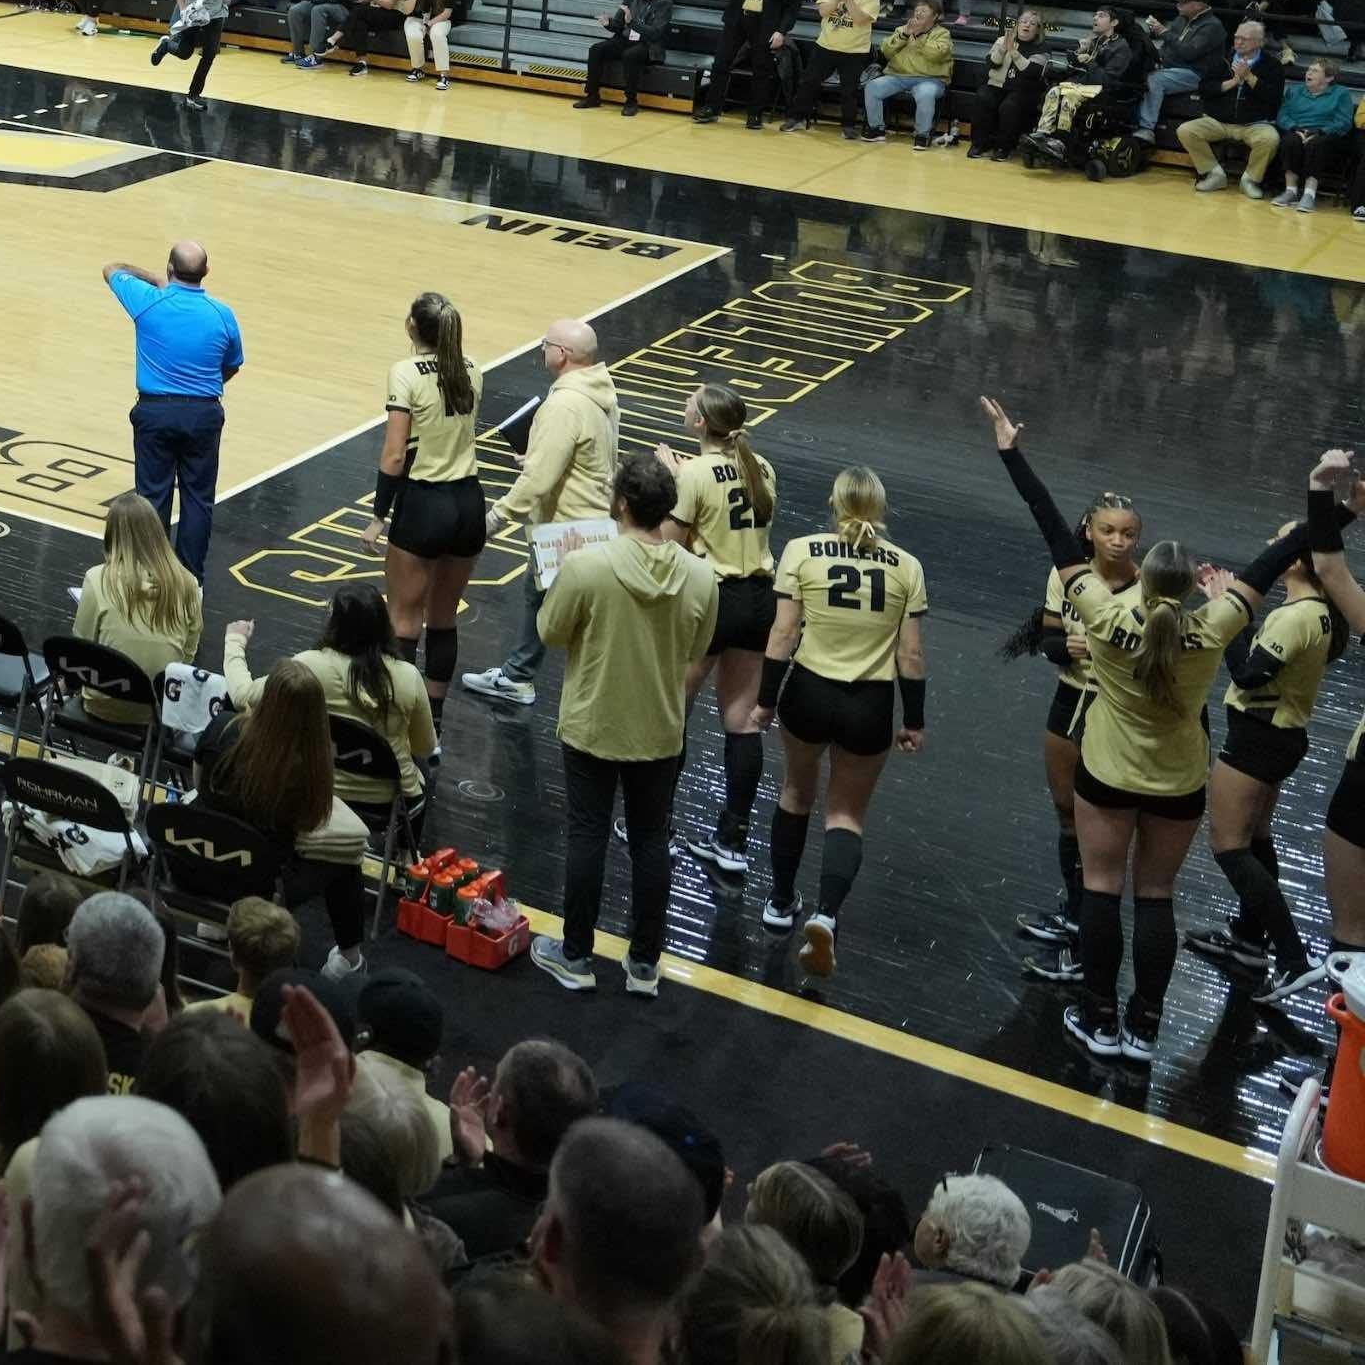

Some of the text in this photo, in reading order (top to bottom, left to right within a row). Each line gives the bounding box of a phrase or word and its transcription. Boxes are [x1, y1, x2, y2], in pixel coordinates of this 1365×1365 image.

[460, 212, 683, 261] BELIN
[827, 564, 885, 612] 21
[16, 776, 99, 813] ROHRMAN
